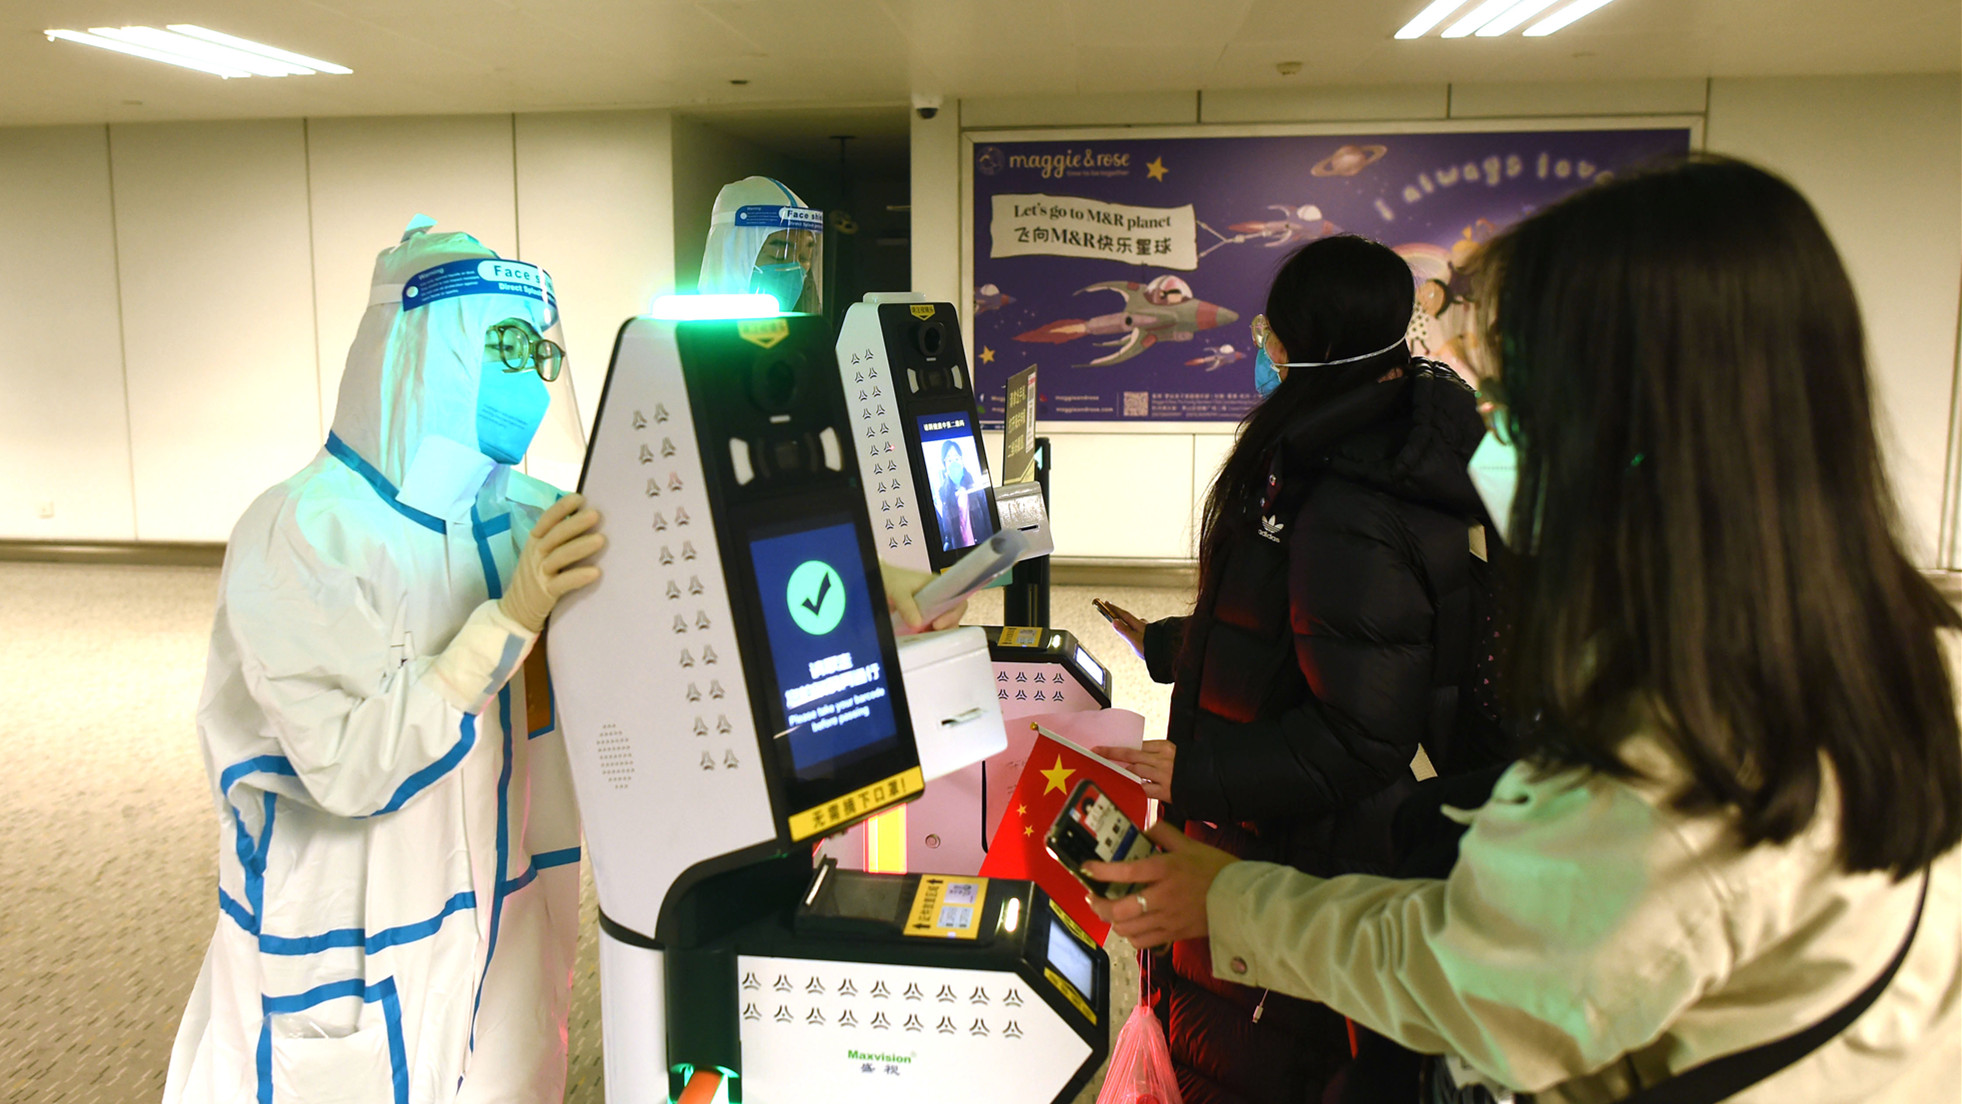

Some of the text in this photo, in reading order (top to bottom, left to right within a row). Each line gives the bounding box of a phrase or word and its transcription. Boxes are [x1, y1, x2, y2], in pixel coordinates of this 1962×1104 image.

[1402, 154, 1523, 204] always
[787, 210, 809, 219] Face
[1014, 202, 1172, 231] Let's go to M&R planet
[1014, 226, 1172, 256] 飞向M&R快乐星球
[493, 265, 530, 281] Face
[498, 282, 523, 293] Direct
[1258, 529, 1280, 543] adidas
[788, 687, 886, 727] Please take your barcode
[811, 705, 870, 733] before passing
[847, 1049, 912, 1064] Maxvision
